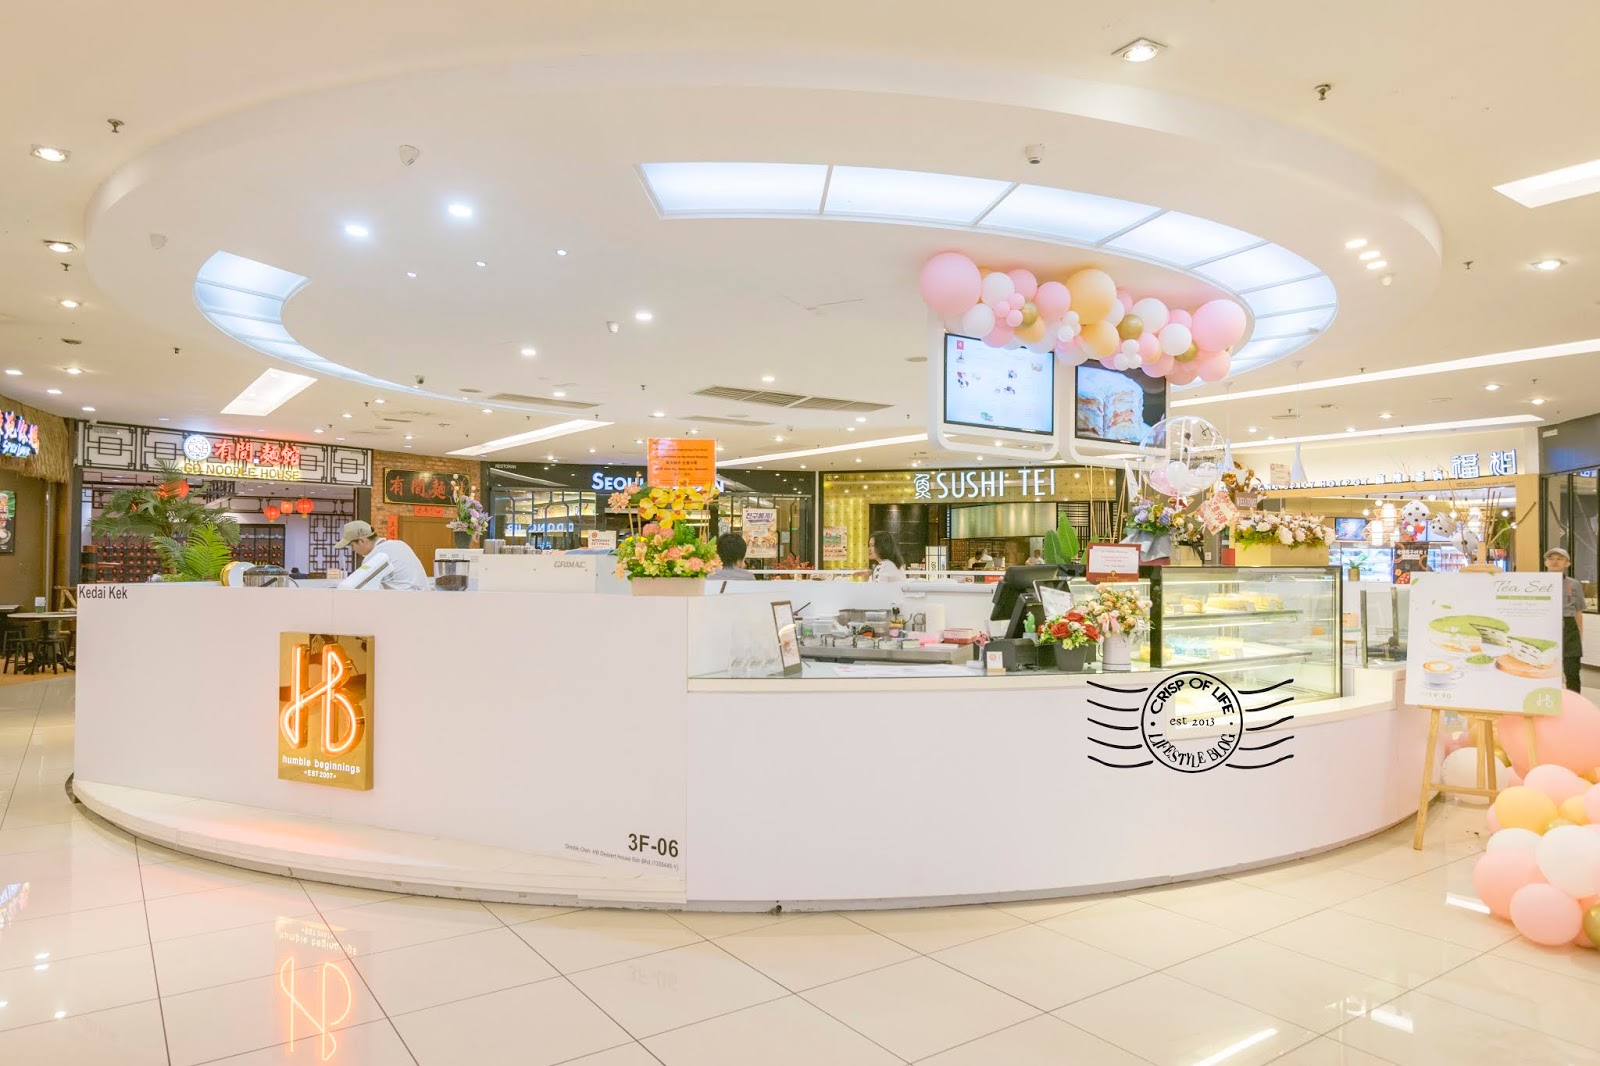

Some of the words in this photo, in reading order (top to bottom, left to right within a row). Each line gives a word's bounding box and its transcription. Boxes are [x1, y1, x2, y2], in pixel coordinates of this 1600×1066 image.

[213, 438, 301, 466] 有間麵館
[206, 465, 257, 476] NOODLE
[261, 468, 300, 479] HOUSE
[937, 472, 1004, 498] SUSHI
[1018, 468, 1055, 496] TEI
[79, 586, 106, 599] Kedai
[108, 586, 128, 599] Kek
[1494, 580, 1518, 592] Tea
[1525, 580, 1553, 592] Set
[282, 755, 311, 767] humble
[314, 759, 361, 774] beginnings
[628, 833, 679, 858] 3F-06
[600, 850, 617, 859] Dessert
[617, 854, 631, 863] House
